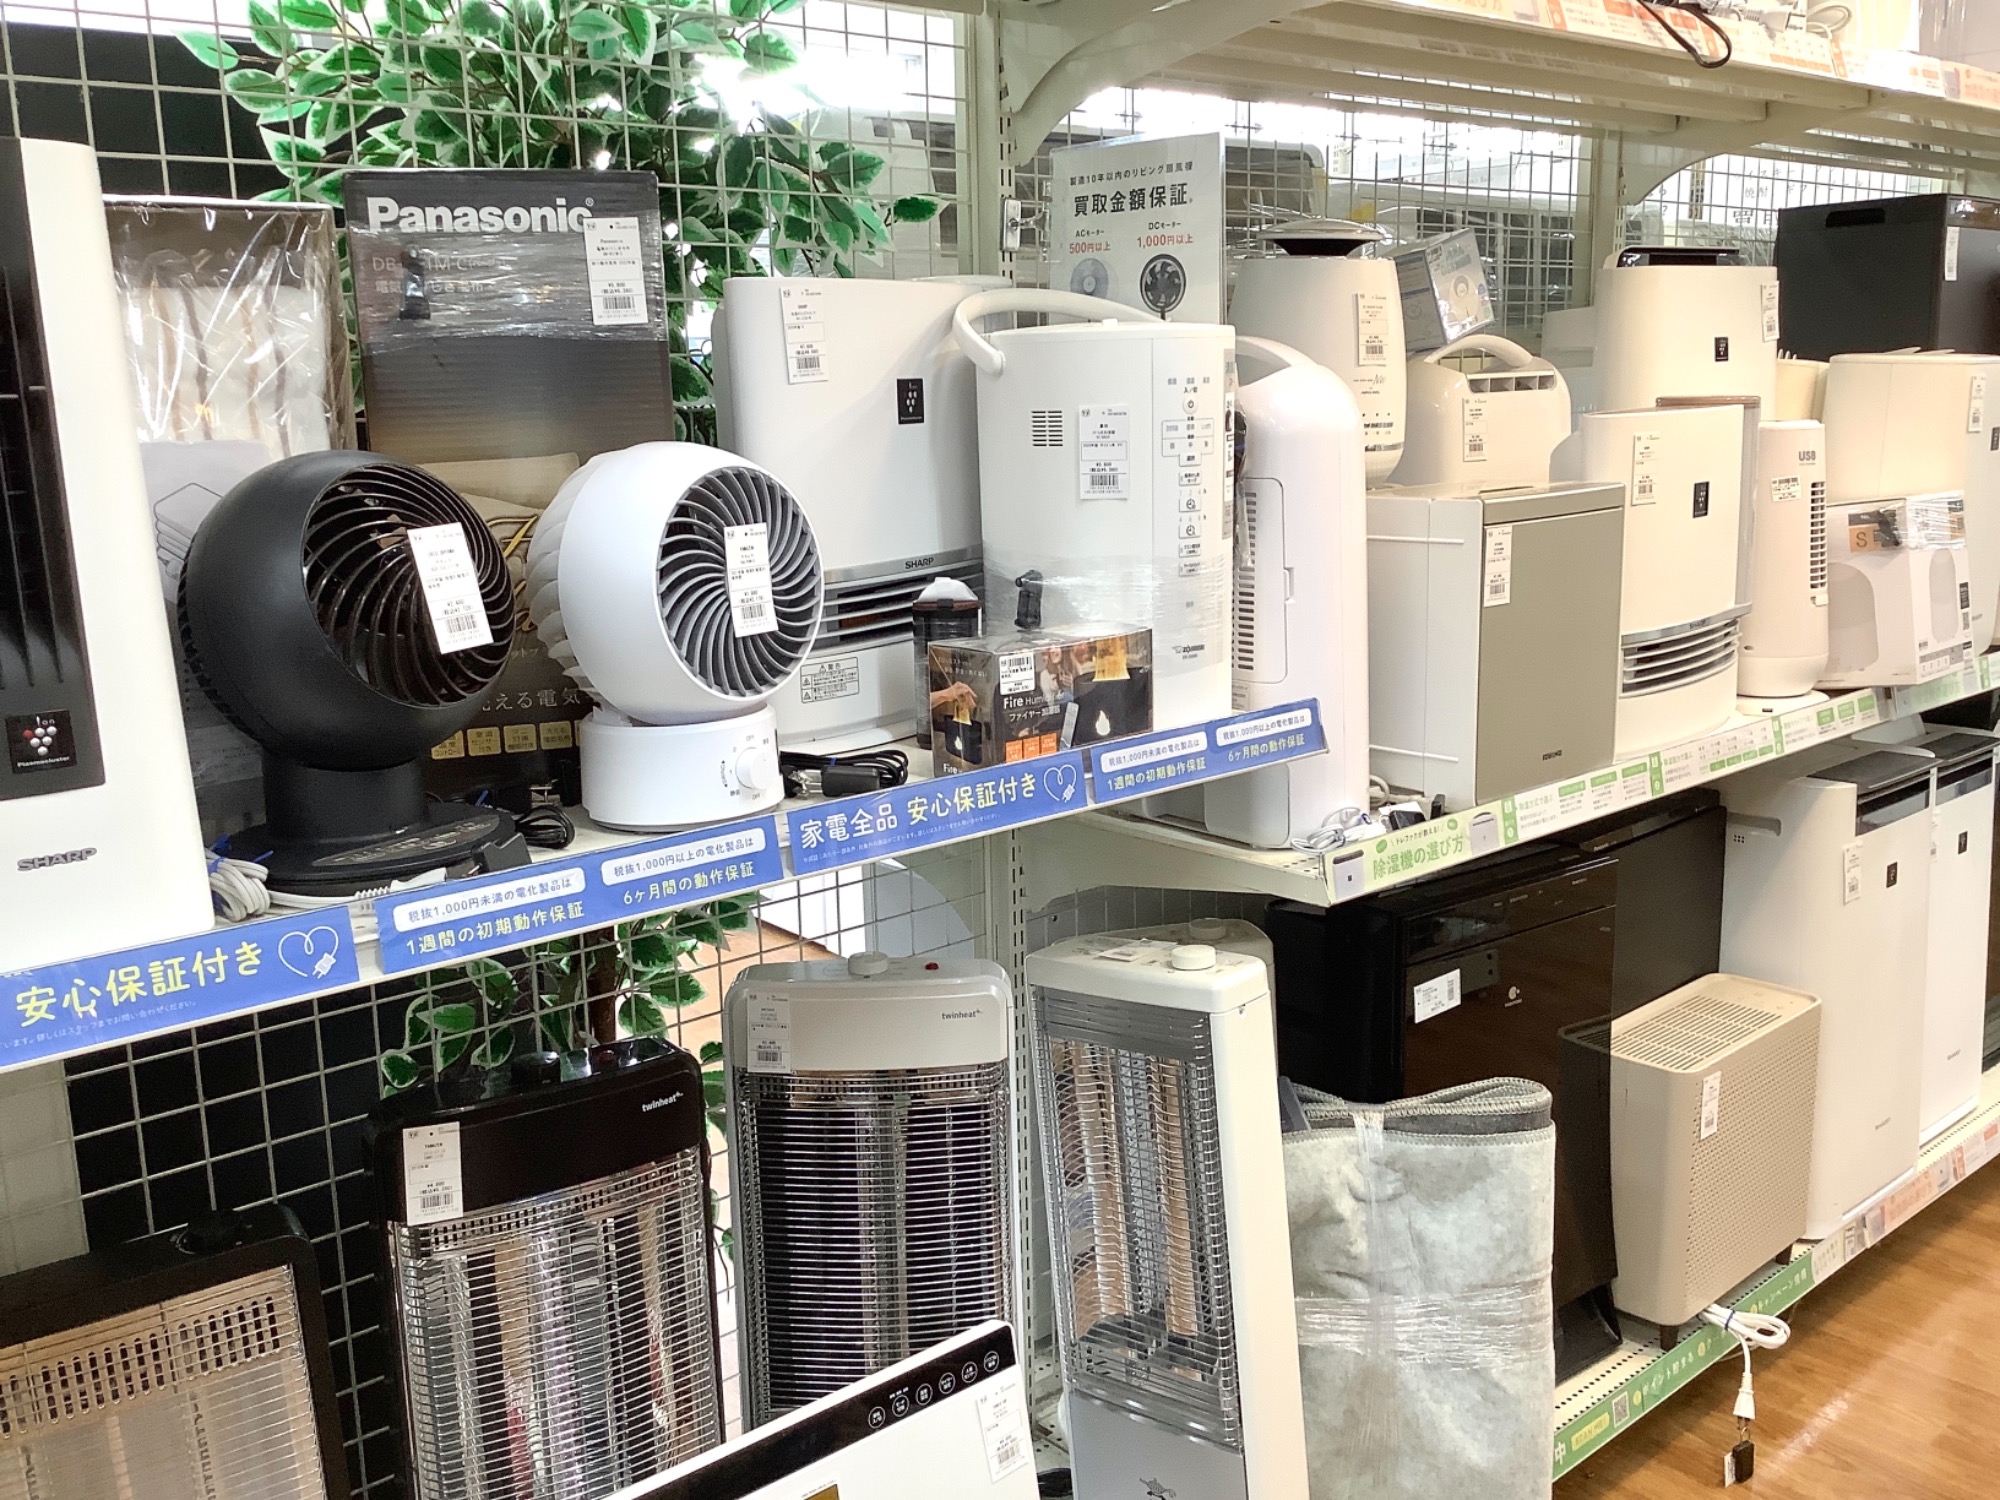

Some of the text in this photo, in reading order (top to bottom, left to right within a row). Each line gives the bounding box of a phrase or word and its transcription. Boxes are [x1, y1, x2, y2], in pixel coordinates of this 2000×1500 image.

[367, 196, 593, 233] Panasonic
[1069, 233, 1193, 254] 500円以上 1,000円以上
[1798, 450, 1816, 461] USB
[1856, 531, 1868, 548] S
[905, 557, 934, 569] SHARP
[1003, 696, 1024, 710] Fire
[17, 755, 70, 768] Plasmacluster
[1107, 757, 1206, 791] 1週間の初期動作保証
[800, 773, 1037, 849] 家電全品 安心保証付き
[17, 847, 98, 872] SHARP
[1373, 835, 1464, 880] 除湿機の選び方
[408, 838, 754, 922] 税抜1,000円未満の電化製品は 税抜1,000円以上の電化製品は
[405, 901, 585, 956] 1週間の初期動作保証
[16, 941, 262, 1027] 安心保証付き
[941, 1010, 977, 1020] twinheat
[641, 1092, 678, 1112] twinheat
